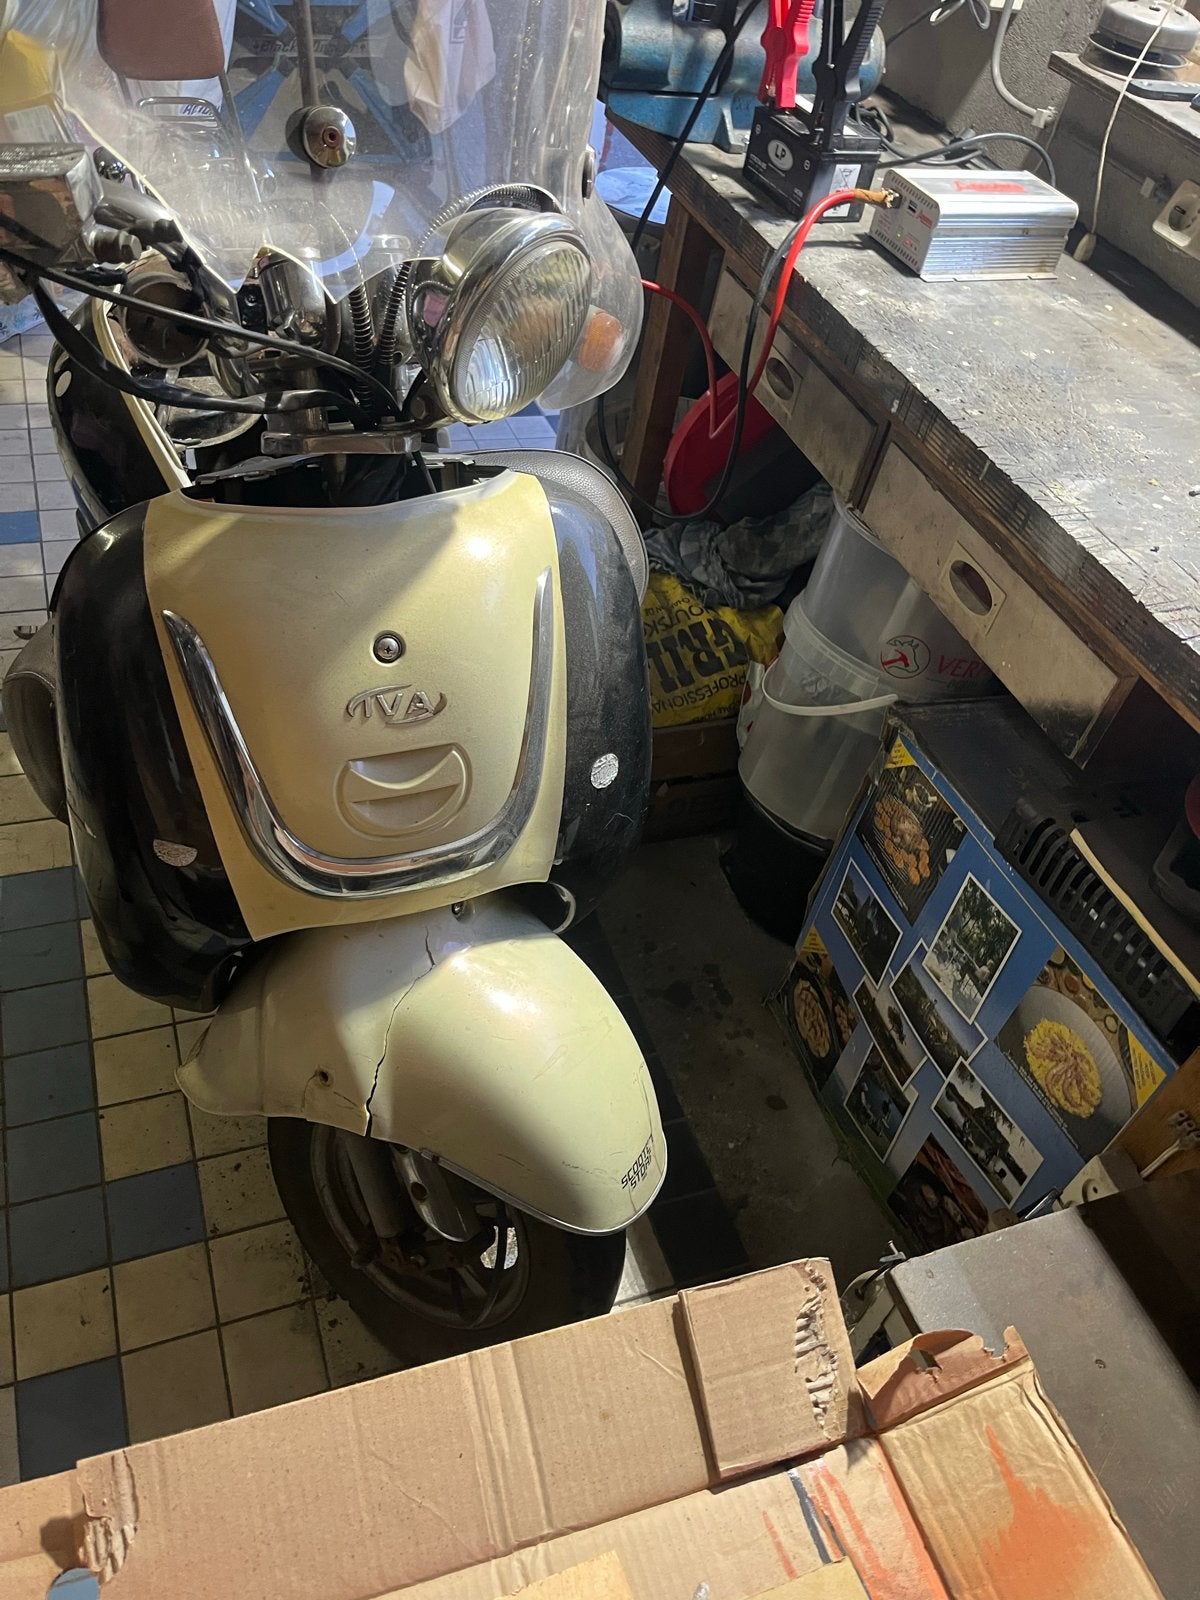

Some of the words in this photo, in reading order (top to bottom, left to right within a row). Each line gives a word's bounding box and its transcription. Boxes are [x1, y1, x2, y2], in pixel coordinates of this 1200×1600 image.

[644, 604, 720, 639] OUTSK
[938, 655, 989, 679] VER
[650, 671, 748, 714] PROFESSIONA
